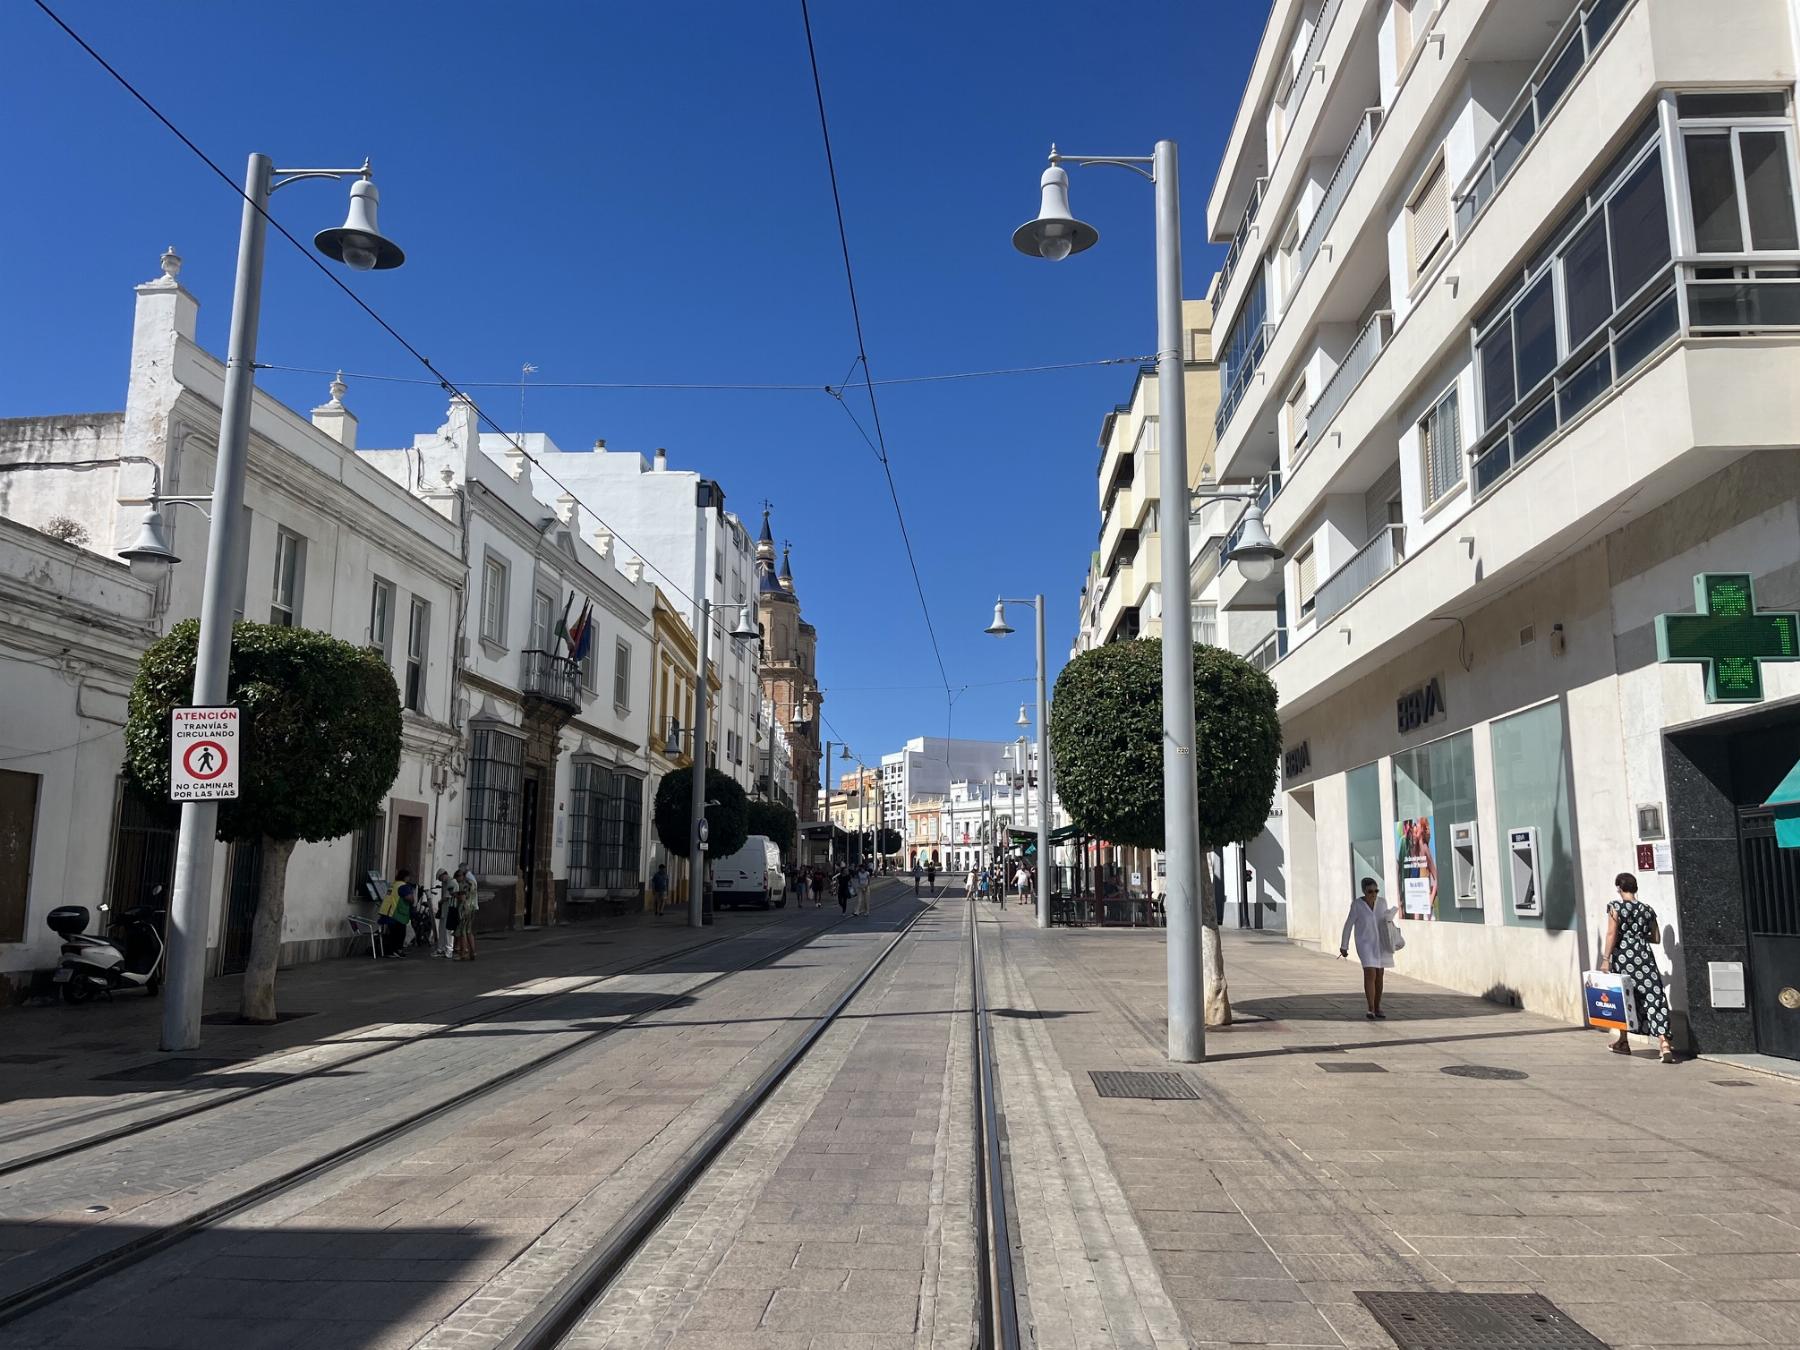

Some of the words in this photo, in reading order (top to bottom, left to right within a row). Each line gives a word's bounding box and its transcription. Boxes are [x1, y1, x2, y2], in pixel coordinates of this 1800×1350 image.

[1397, 677, 1444, 733] BBVA
[175, 710, 237, 721] ATENCIÓN
[184, 722, 228, 730] TRANVÍAS
[176, 730, 235, 738] CIRCULANDO
[1285, 740, 1311, 778] BBVA
[192, 782, 234, 790] CAMINAR
[216, 788, 236, 797] VÍAS
